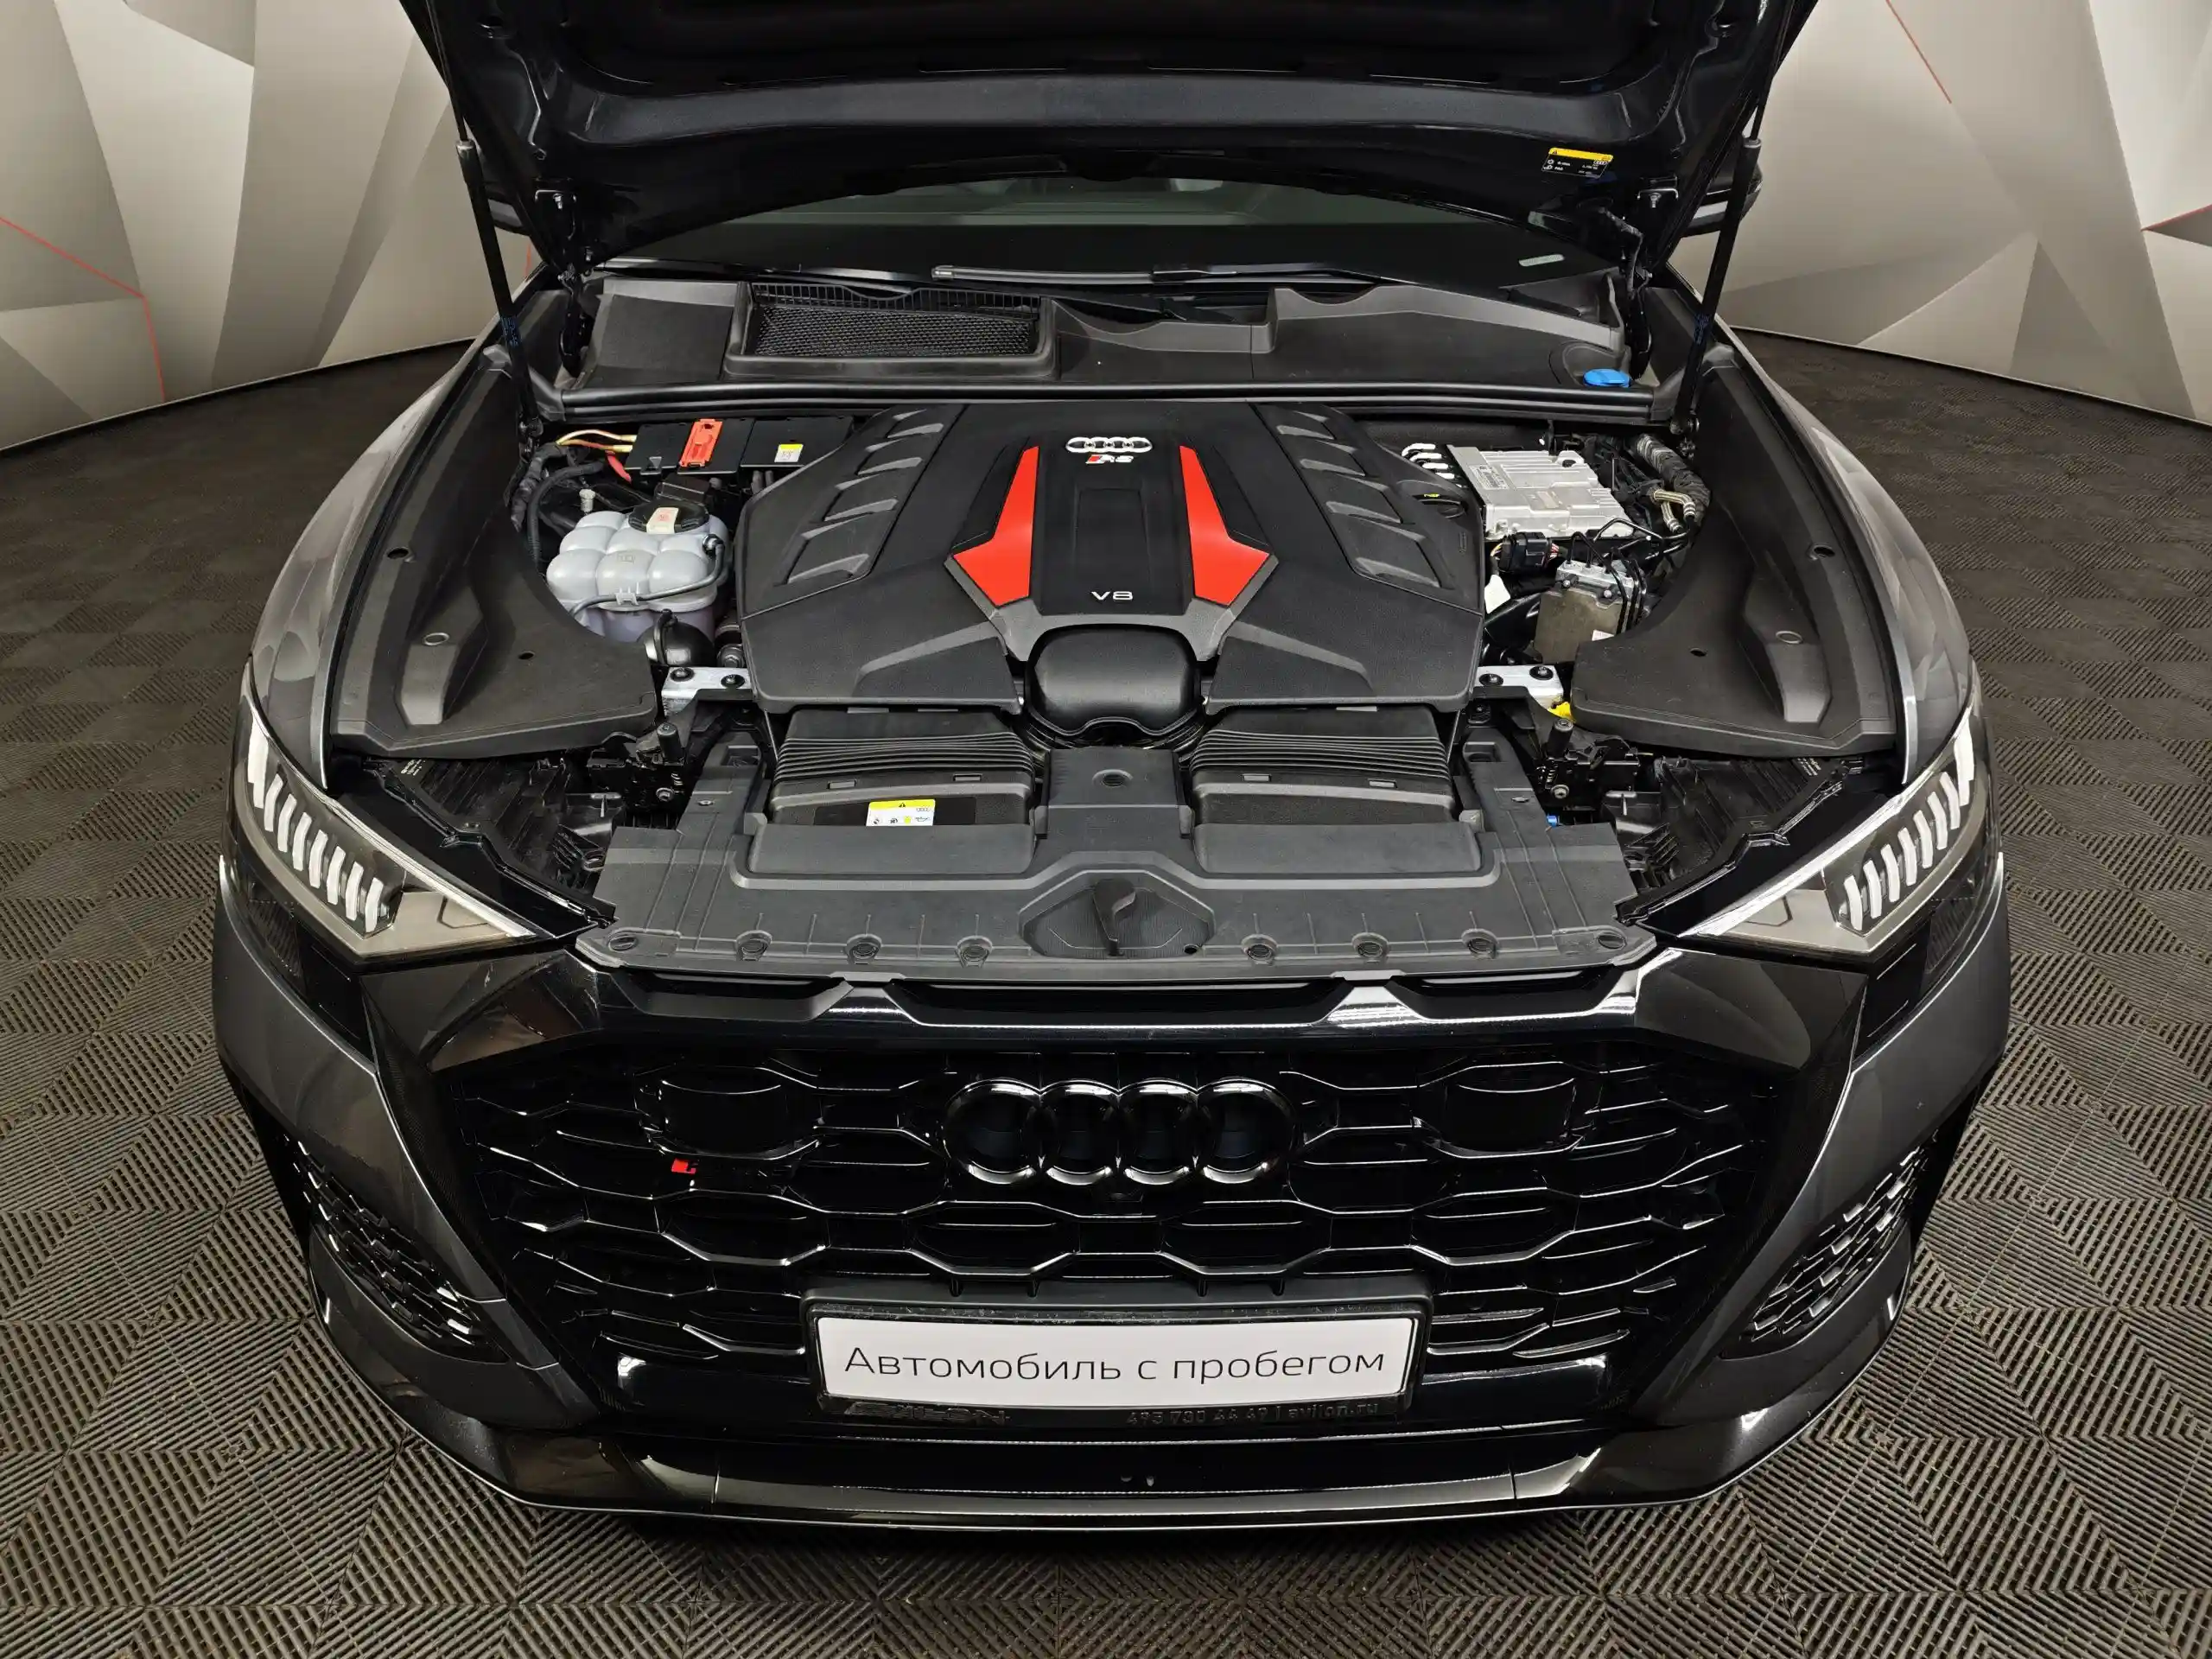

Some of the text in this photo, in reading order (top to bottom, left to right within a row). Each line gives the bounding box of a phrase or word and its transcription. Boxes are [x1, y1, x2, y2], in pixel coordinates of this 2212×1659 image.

[1090, 591, 1134, 601] V8
[844, 1347, 1384, 1385] Автомобиль с пробегом
